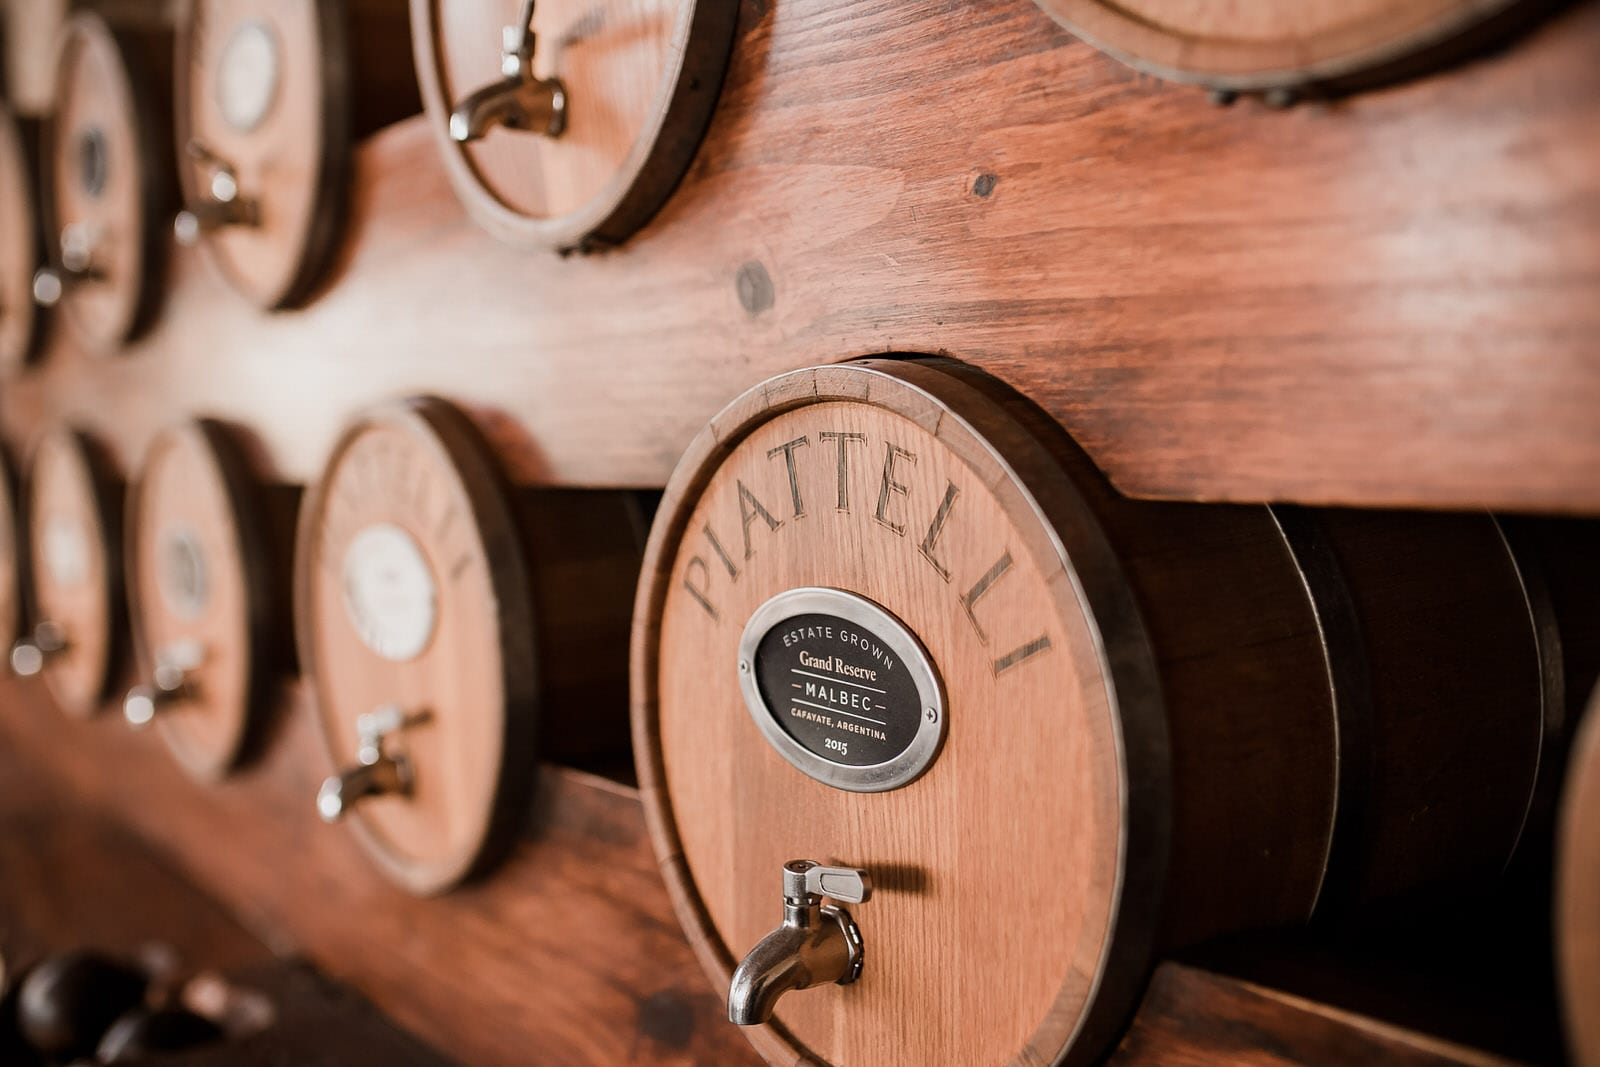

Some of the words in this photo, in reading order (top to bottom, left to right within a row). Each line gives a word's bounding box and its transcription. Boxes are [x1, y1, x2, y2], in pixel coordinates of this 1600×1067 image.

[683, 431, 1051, 681] PIATTELLI
[783, 627, 833, 647] ESTATE
[840, 630, 894, 670] GROWN
[799, 650, 832, 672] Grand
[835, 658, 877, 682] Reserve
[806, 682, 871, 711] MALBEC
[791, 707, 834, 727] CAFAYATE,
[837, 720, 886, 741] ARGENTINA
[825, 738, 848, 756] 2015
